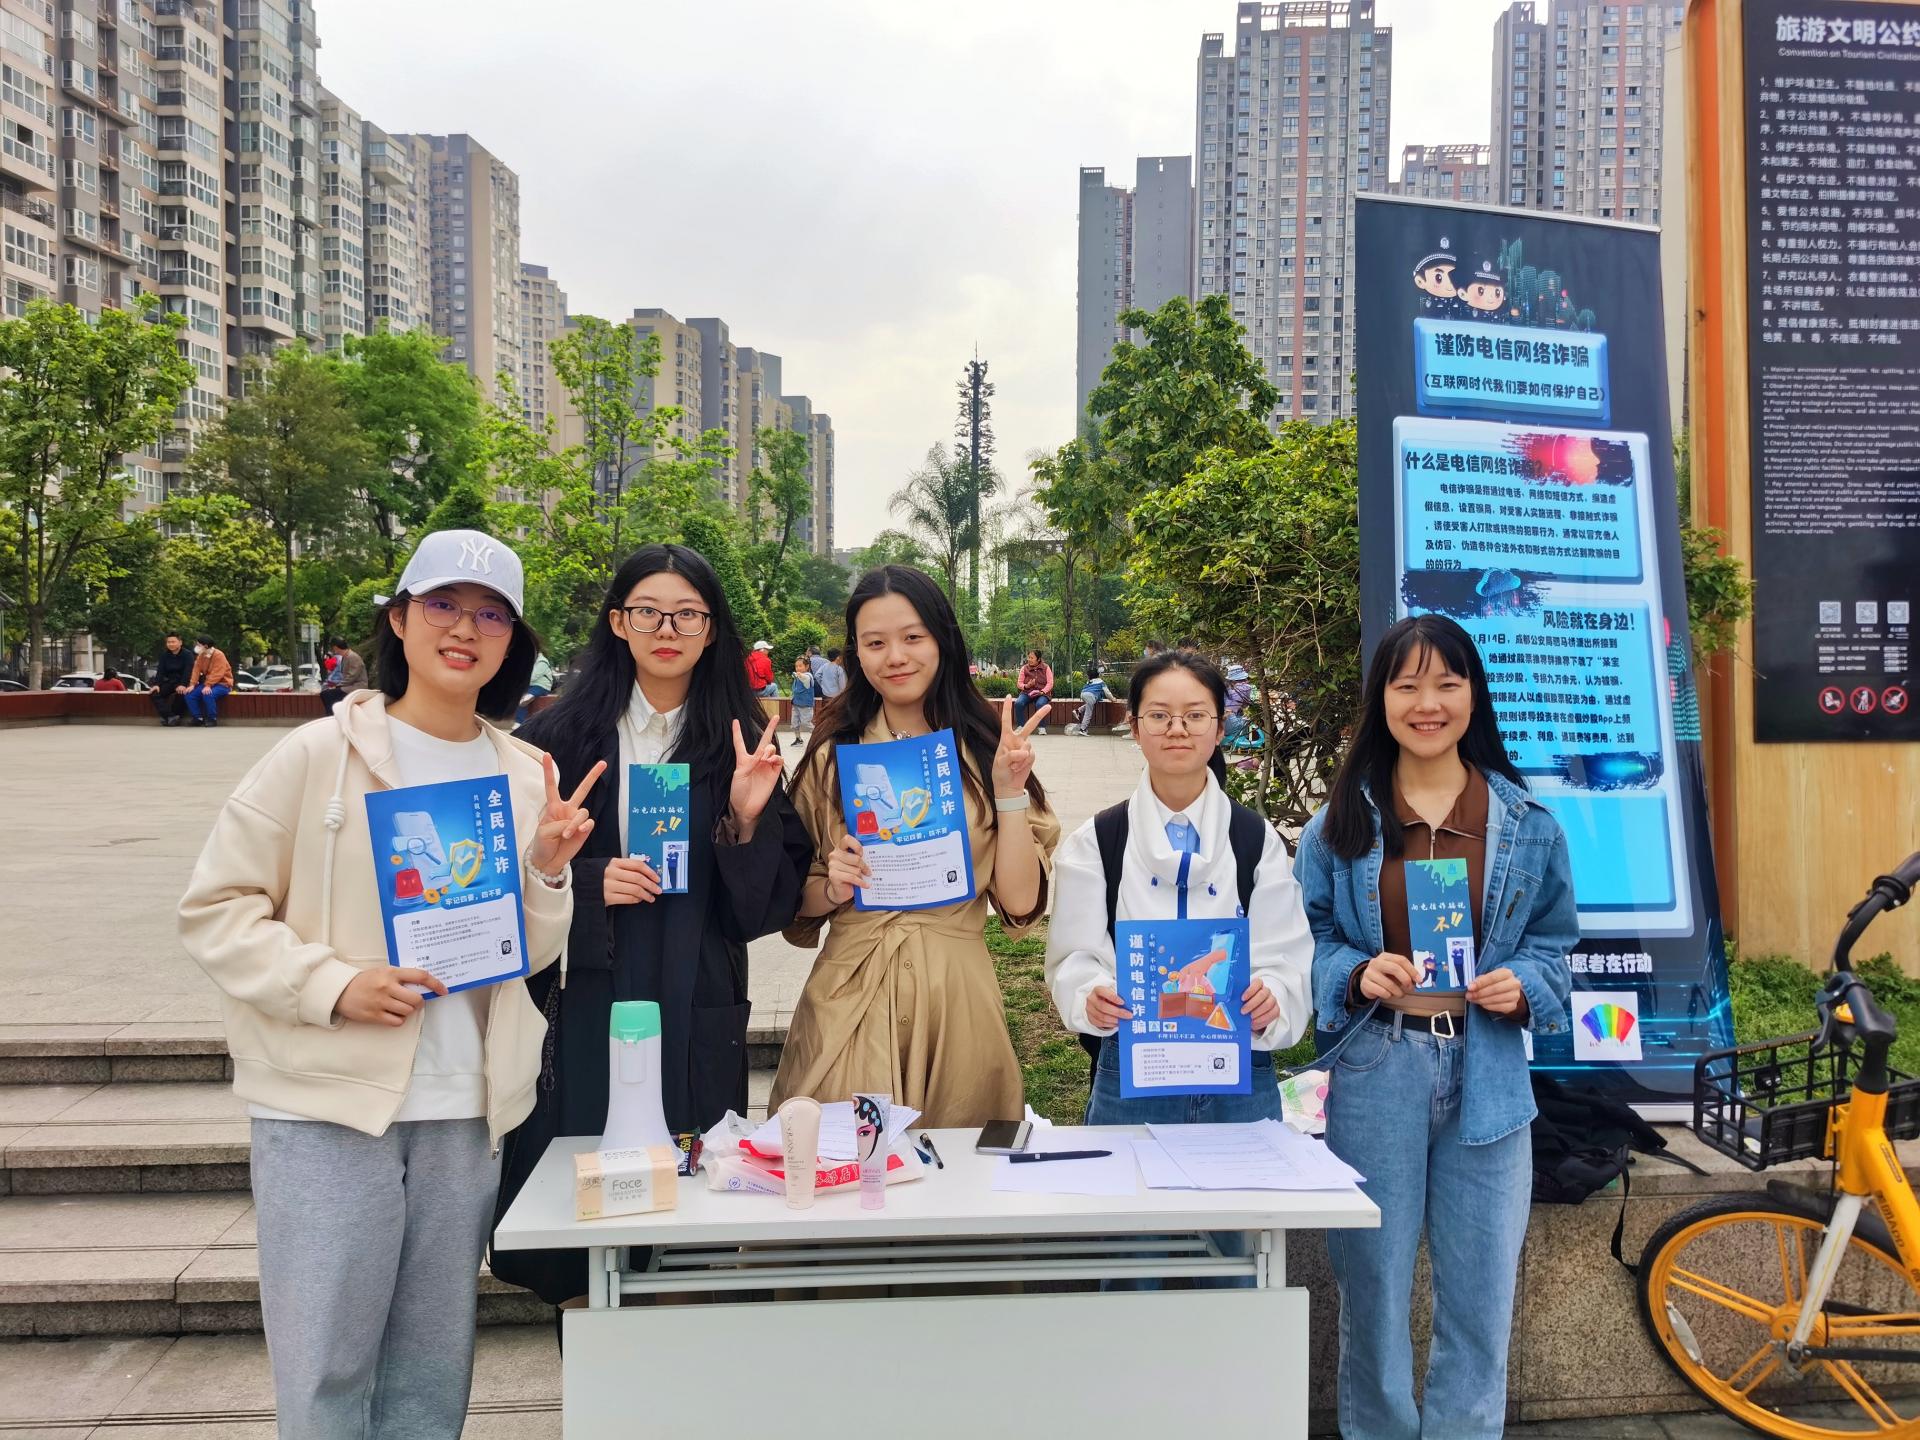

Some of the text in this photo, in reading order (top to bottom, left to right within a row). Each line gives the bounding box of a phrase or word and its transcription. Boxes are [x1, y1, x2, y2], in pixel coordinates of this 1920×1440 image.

[1776, 15, 1920, 46] 旅游文明公约
[1435, 333, 1589, 368] 谨防电信网络诈骗
[456, 536, 494, 575] NY
[1543, 610, 1636, 631] 风险就在身边!
[934, 743, 956, 816] 全民反诈
[488, 789, 510, 874] 全民反诈
[1128, 934, 1147, 1034] 谨防电信诈骗
[612, 1179, 642, 1191] Face
